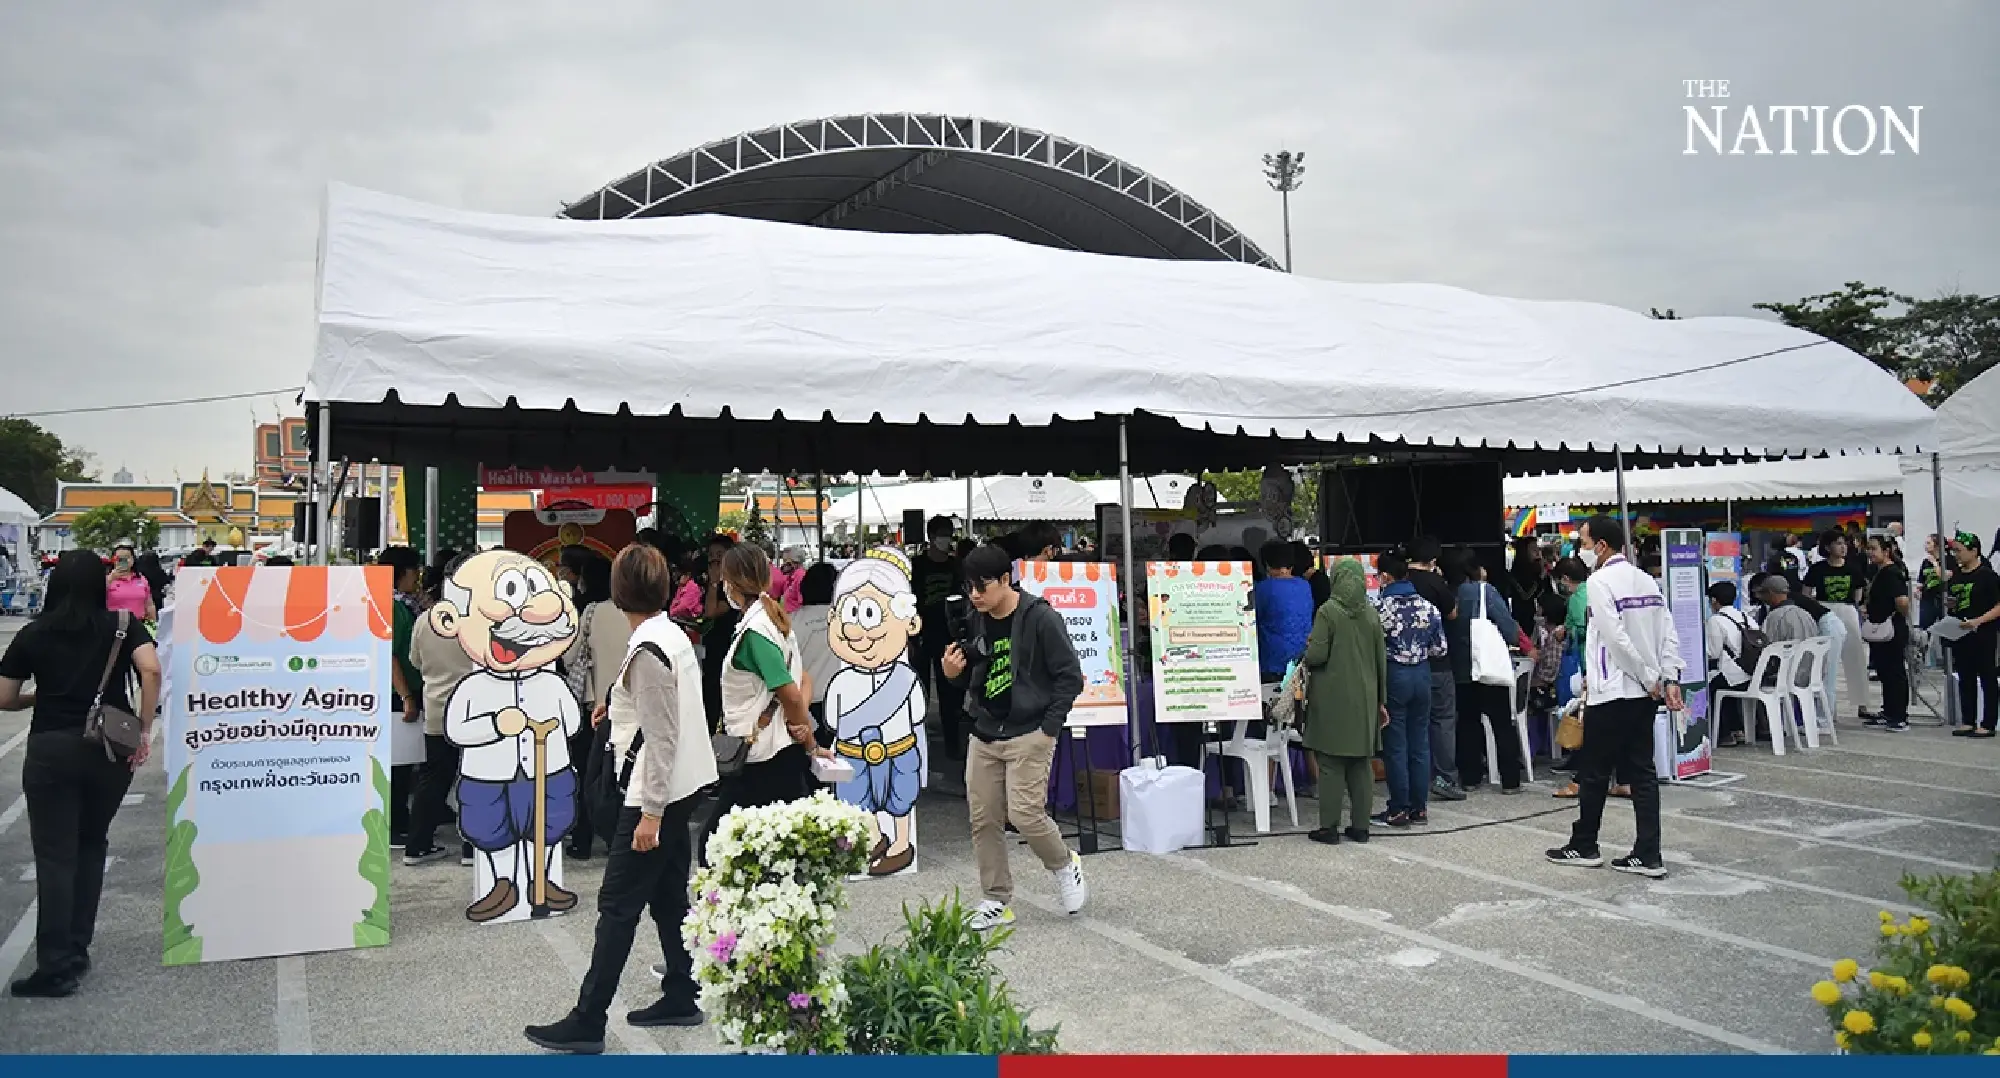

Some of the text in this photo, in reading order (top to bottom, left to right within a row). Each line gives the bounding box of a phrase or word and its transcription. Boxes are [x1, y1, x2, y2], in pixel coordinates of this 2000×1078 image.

[488, 471, 588, 484] Health Market
[1050, 588, 1087, 606] ฐานที่ 2
[1065, 616, 1093, 625] กรอง
[1091, 631, 1098, 642] &
[187, 686, 376, 713] Healthy Aging
[185, 718, 378, 749] สูงวัยอย่างมีคุณภาพ
[199, 769, 361, 794] กรุงเทพฝั่งตะวันออก
